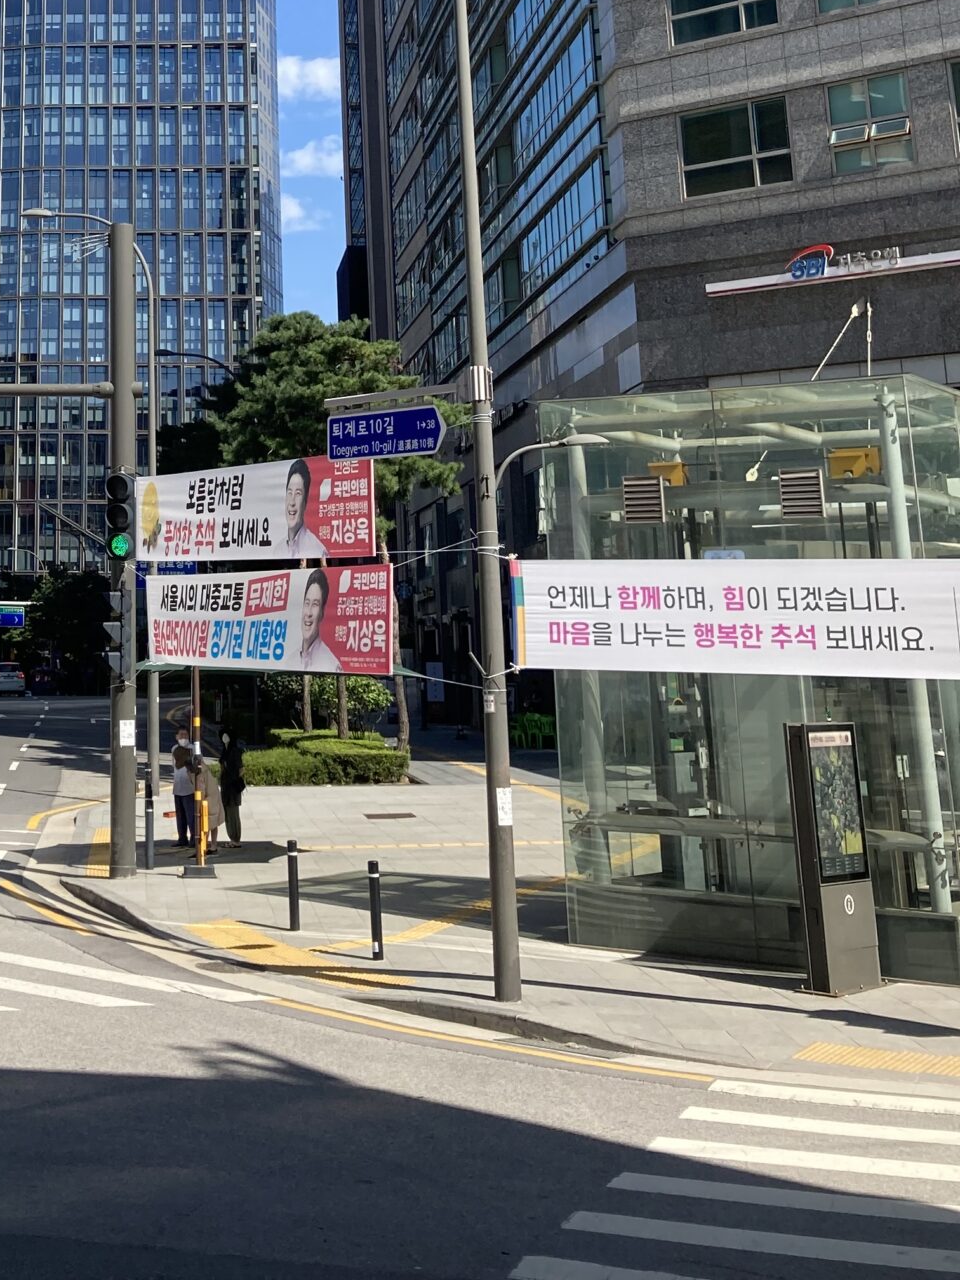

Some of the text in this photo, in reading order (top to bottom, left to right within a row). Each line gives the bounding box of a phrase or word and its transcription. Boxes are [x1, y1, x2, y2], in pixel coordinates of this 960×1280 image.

[791, 246, 900, 279] SBI 저축은행
[332, 416, 394, 439] 퇴계로10길
[332, 443, 369, 458] Toegye-ro
[186, 474, 244, 514] 보름달처럼
[334, 478, 368, 497] 국민의힘
[164, 517, 272, 557] 풍성한 추석 보내세요
[331, 517, 369, 544] 지상욱
[160, 578, 287, 612] 서울시의 대중교통 무제한
[353, 571, 387, 590] 국민의힘
[547, 585, 906, 613] 언제나 함께하며, 힘이 되겠습니다.
[153, 619, 288, 661] 월6만5000원 정기권 대환영
[346, 619, 387, 653] 지상욱
[548, 621, 934, 652] 마음을 나누는 행복한 추석 보내세요.
